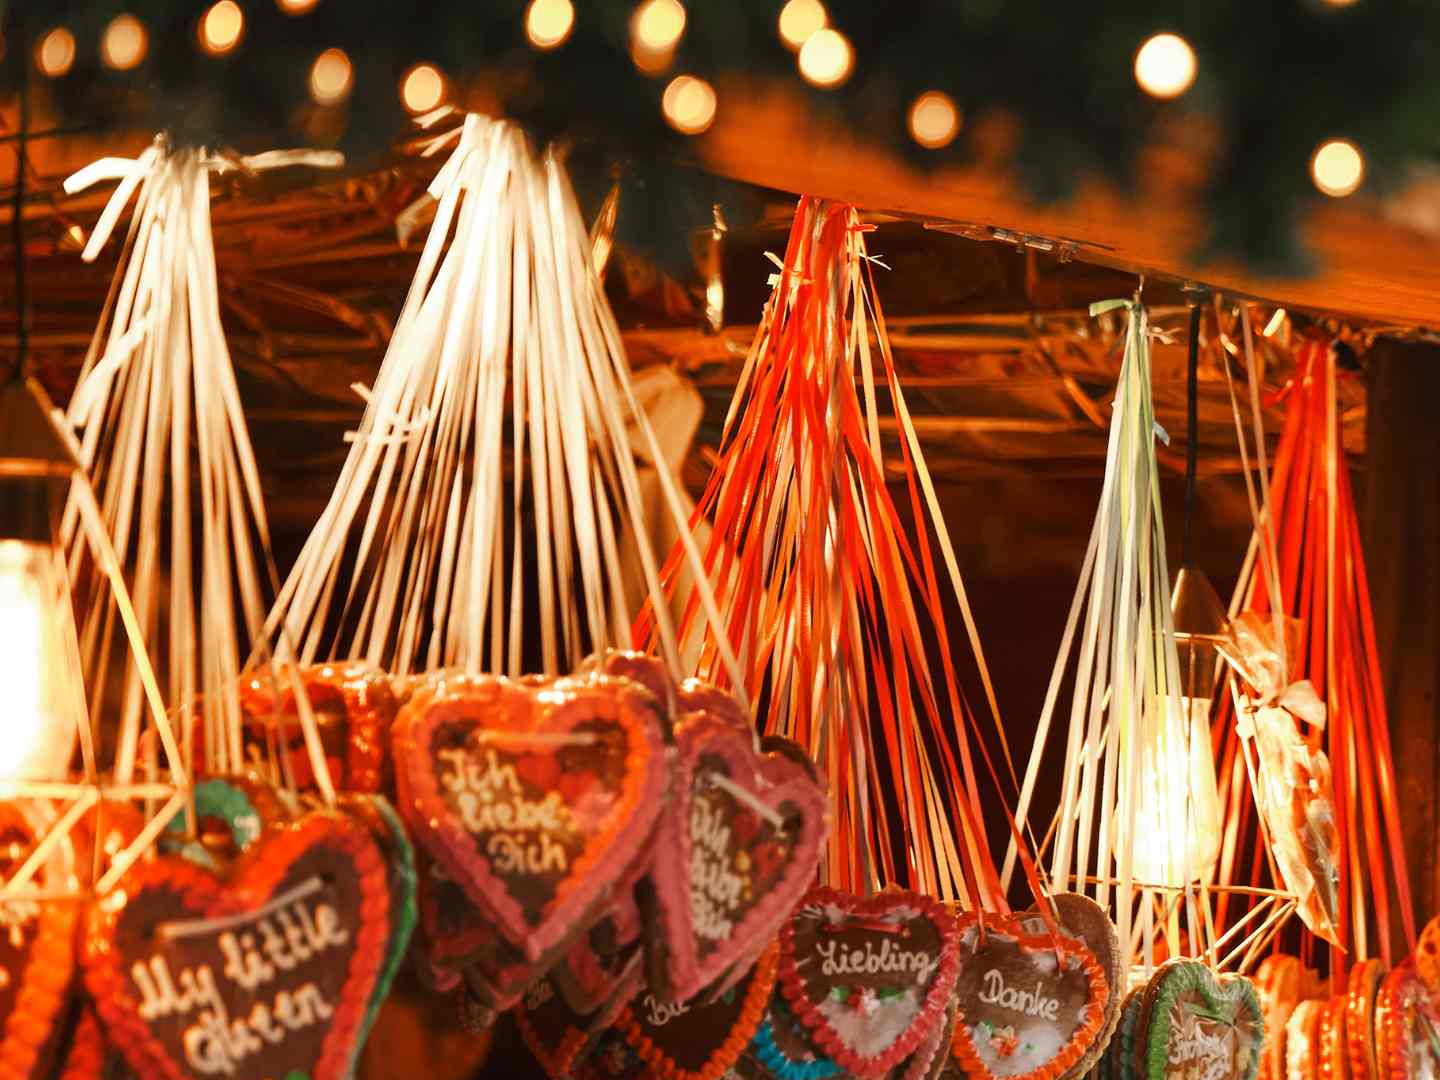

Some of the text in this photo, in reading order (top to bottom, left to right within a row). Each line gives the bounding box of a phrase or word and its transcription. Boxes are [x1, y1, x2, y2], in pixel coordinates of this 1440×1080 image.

[131, 902, 349, 1042] My little
[815, 937, 930, 986] Liebling
[978, 968, 1059, 1021] Danke
